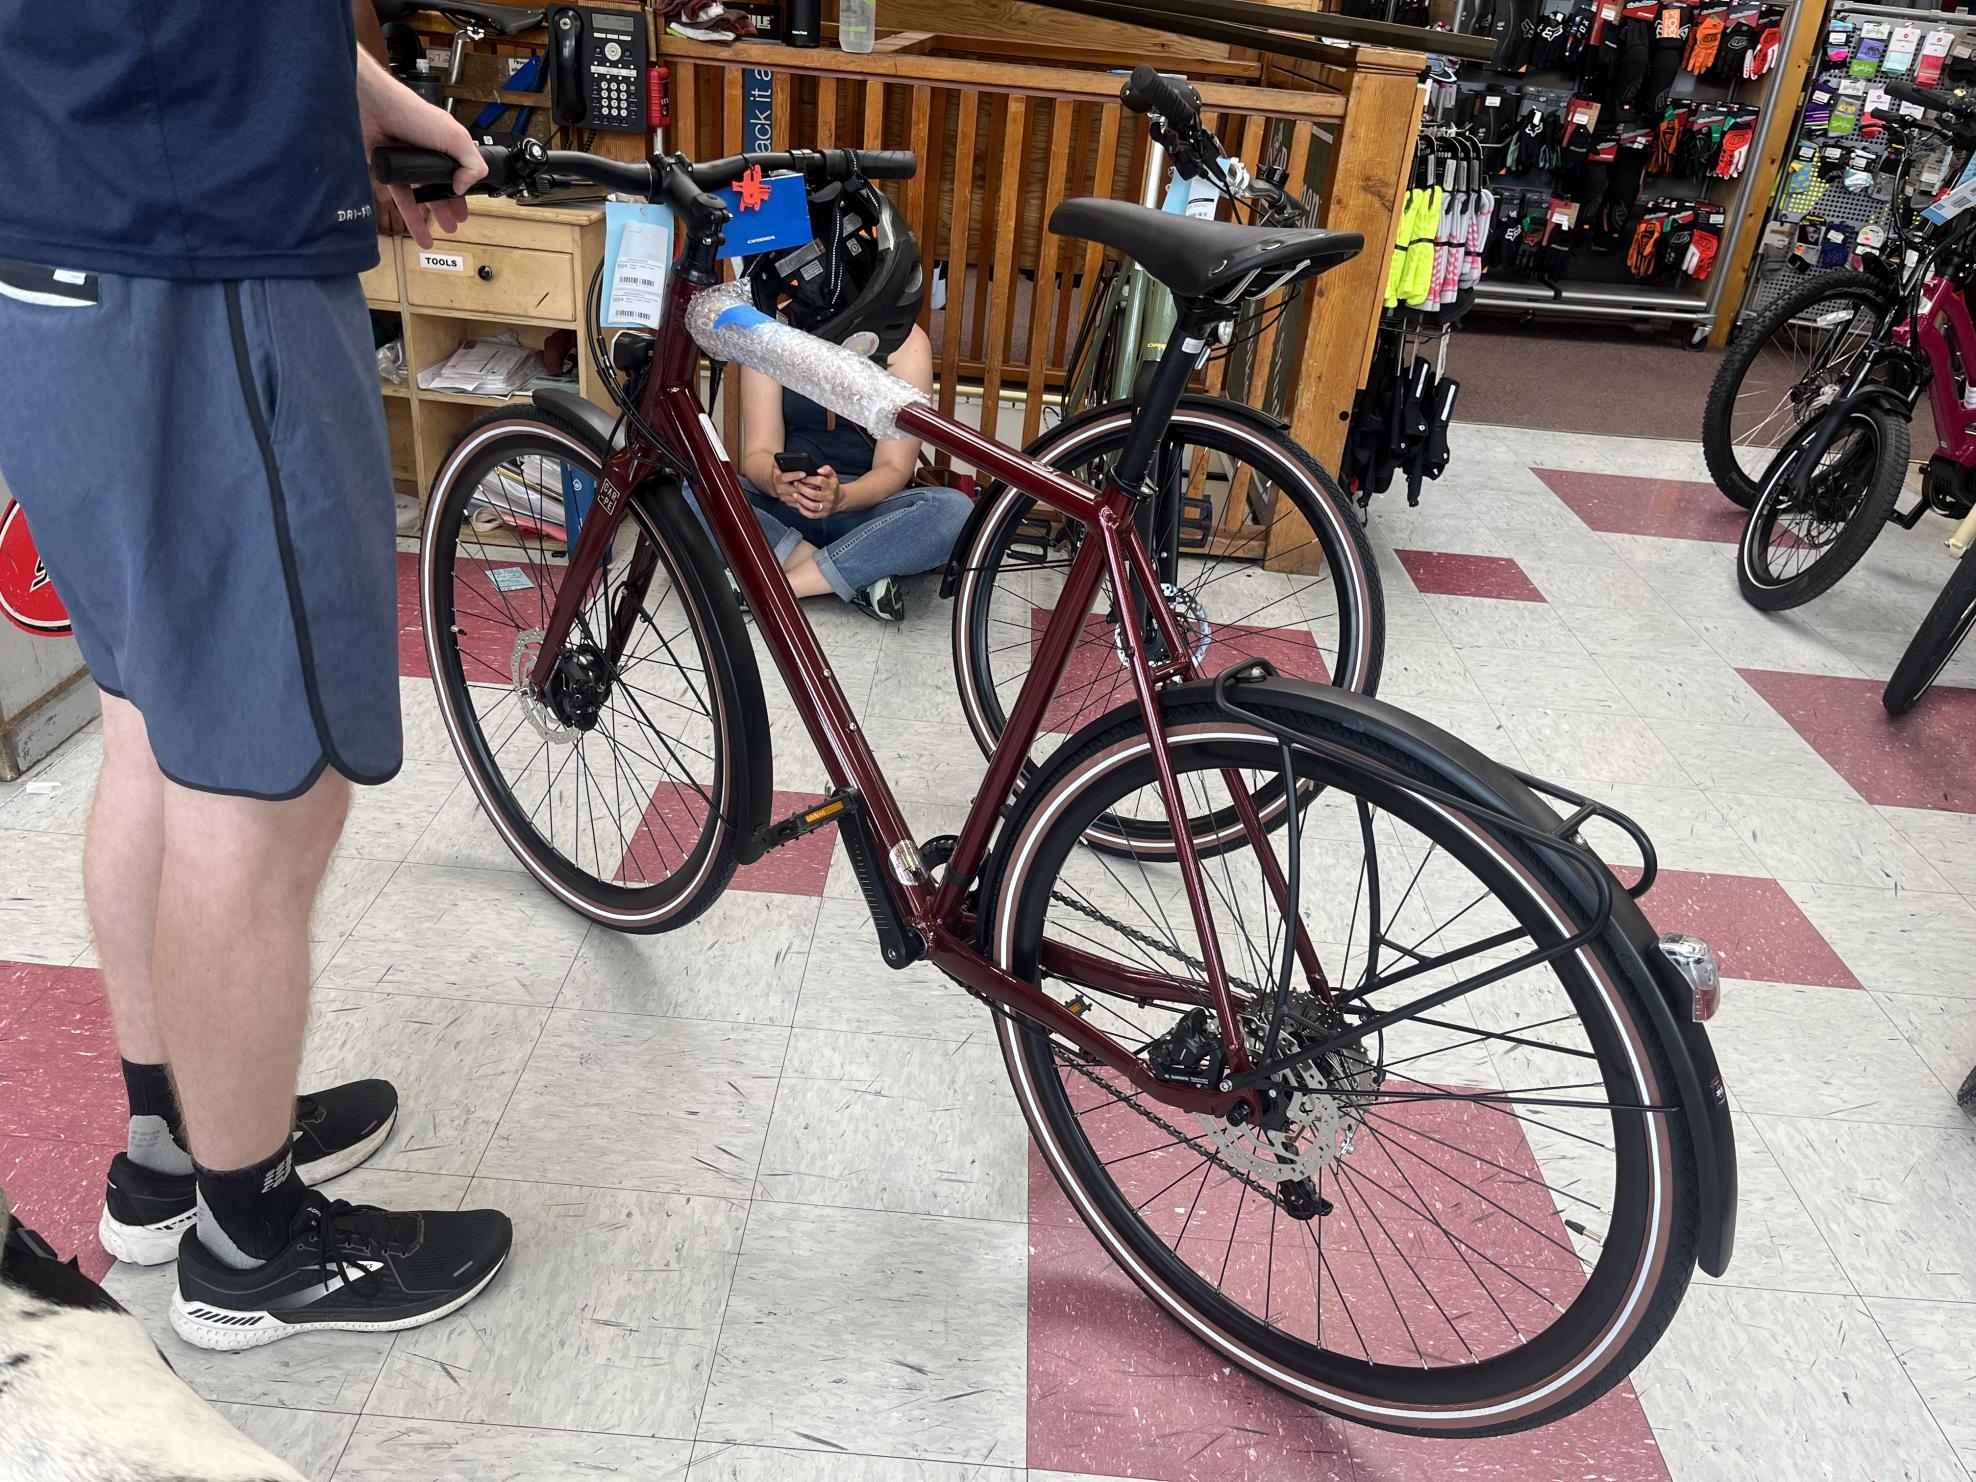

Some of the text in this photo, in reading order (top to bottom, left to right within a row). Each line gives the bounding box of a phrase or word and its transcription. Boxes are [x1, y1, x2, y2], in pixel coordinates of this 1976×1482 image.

[750, 88, 771, 101] it
[425, 257, 457, 267] TOOLS
[603, 482, 617, 501] CAR
